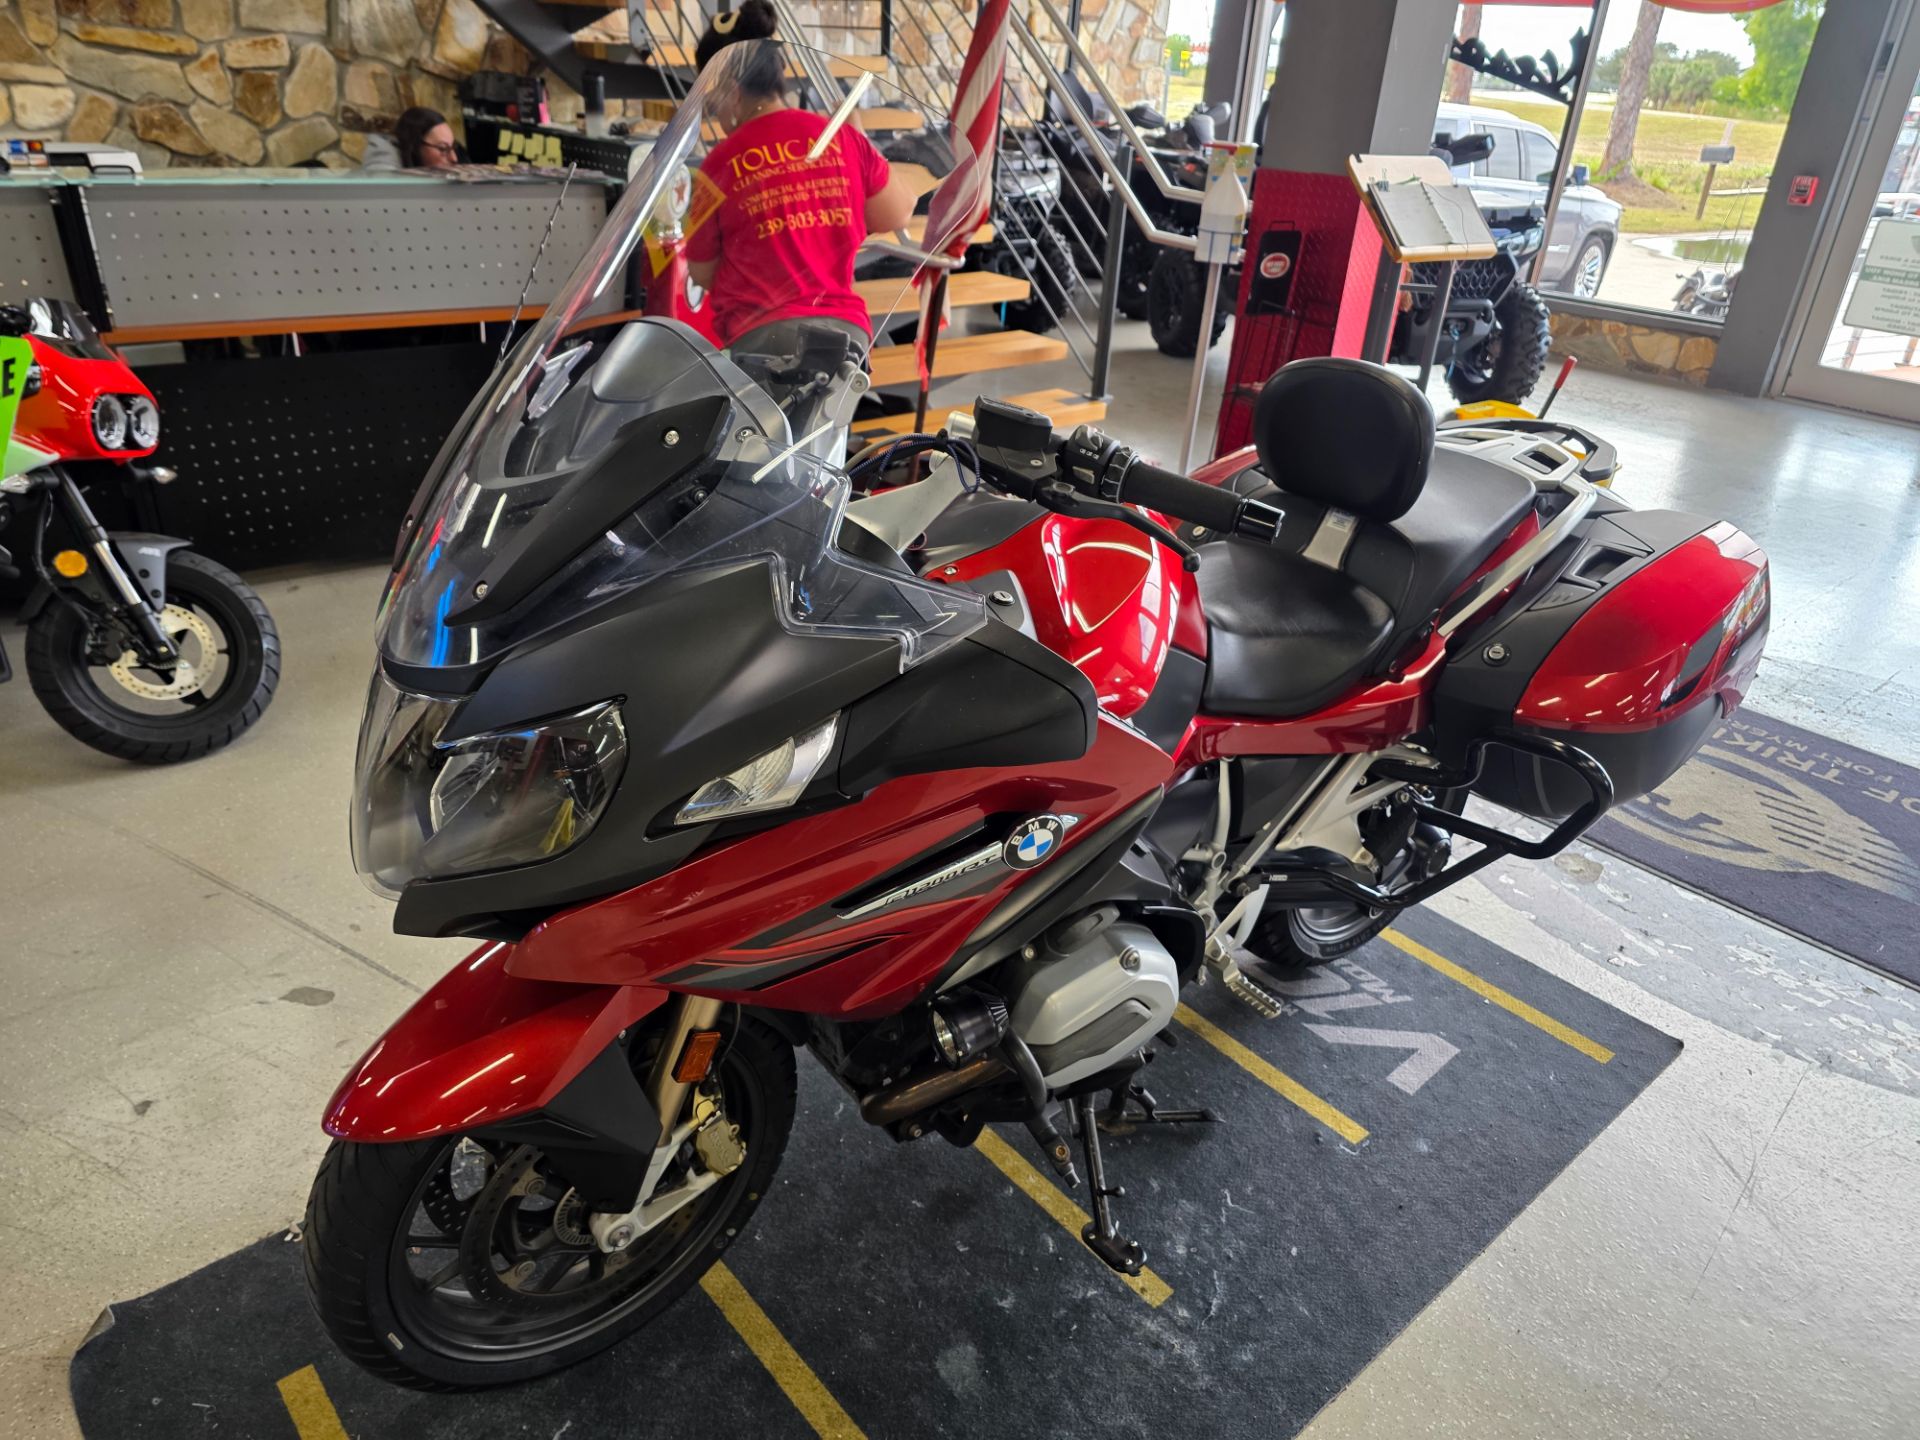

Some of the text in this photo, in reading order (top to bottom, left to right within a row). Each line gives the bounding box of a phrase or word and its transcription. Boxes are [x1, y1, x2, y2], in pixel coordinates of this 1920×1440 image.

[757, 208, 852, 239] 239-303-3057
[1727, 719, 1808, 752] MYER
[1010, 819, 1059, 846] BMW
[883, 853, 997, 906] R1200RT
